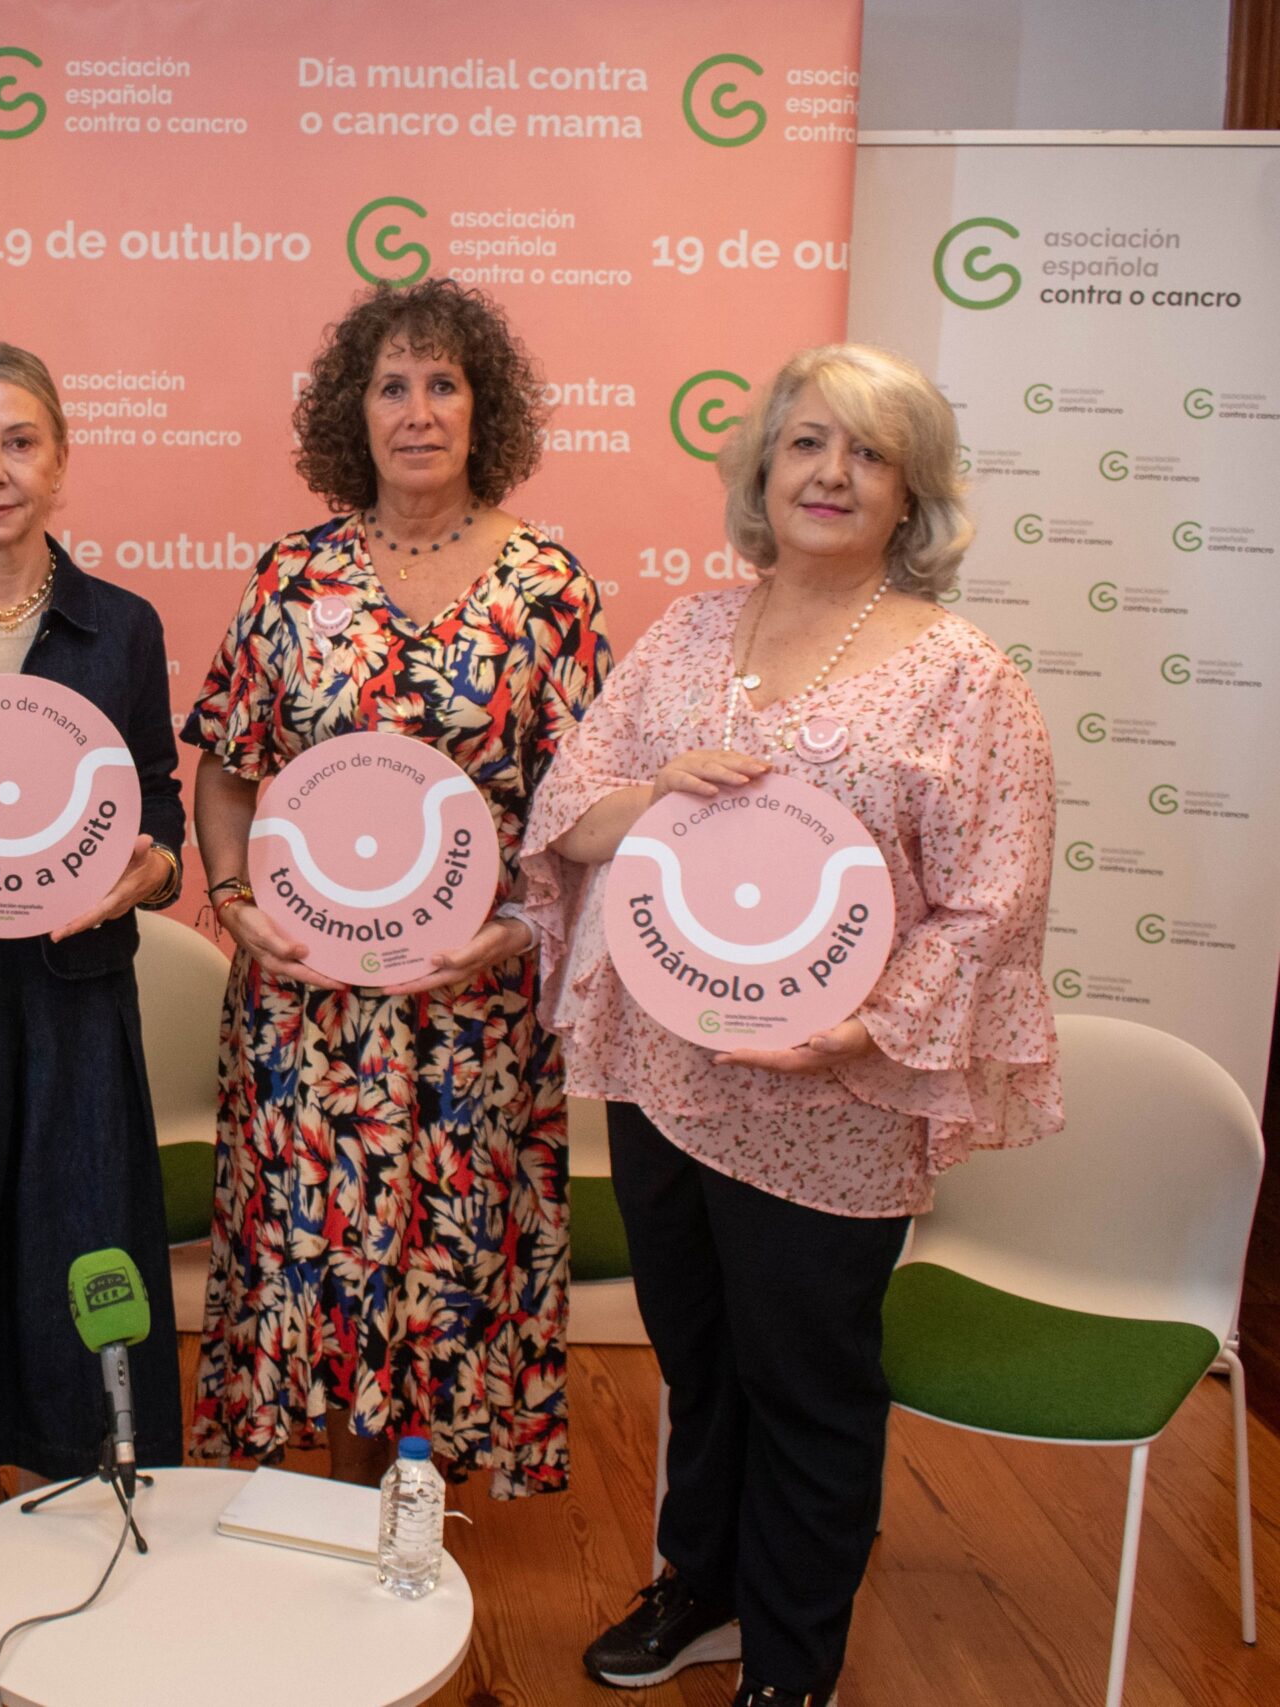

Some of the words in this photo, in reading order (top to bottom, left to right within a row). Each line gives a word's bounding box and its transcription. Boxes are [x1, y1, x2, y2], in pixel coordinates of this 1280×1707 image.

[65, 57, 190, 77] asociación
[299, 57, 357, 88] Día
[368, 58, 519, 90] mundial
[528, 62, 649, 92] contra
[65, 85, 172, 108] española
[785, 94, 857, 118] españ
[65, 112, 140, 132] contra
[147, 116, 161, 132] o
[167, 117, 248, 134] cancro
[300, 111, 323, 134] o
[332, 112, 459, 136] cancro
[470, 107, 517, 137] de
[528, 114, 643, 139] mama
[450, 208, 576, 230] asociación
[45, 219, 107, 260] de
[119, 222, 311, 262] outubro
[450, 236, 557, 259] española
[1044, 227, 1181, 249] asociación
[652, 235, 705, 275] 19
[718, 229, 781, 270] de
[449, 263, 523, 284] contra
[531, 268, 545, 284] o
[551, 268, 633, 286] cancro
[1042, 255, 1159, 281] española
[1040, 284, 1122, 305] contra
[1129, 290, 1145, 306] o
[1151, 290, 1242, 308] cancro
[62, 370, 185, 391] asociación
[538, 377, 636, 407] ontra
[63, 397, 168, 422] española
[142, 429, 156, 446] o
[162, 430, 242, 446] cancro
[639, 547, 691, 586] 19
[16, 697, 38, 713] de
[42, 706, 88, 747] mama
[288, 797, 301, 811] O
[299, 759, 347, 797] cancro
[351, 754, 373, 768] de
[377, 756, 426, 785] mama
[672, 822, 687, 837] O
[690, 796, 750, 825] cancro
[755, 794, 780, 811] de
[784, 803, 835, 846] mama
[36, 868, 56, 887] a
[61, 800, 117, 878] peito
[270, 866, 403, 942] tomámolo
[412, 907, 433, 926] a
[433, 828, 472, 911] peito
[630, 894, 764, 1002] tomámolo
[779, 976, 802, 997] a
[807, 903, 869, 988] peito
